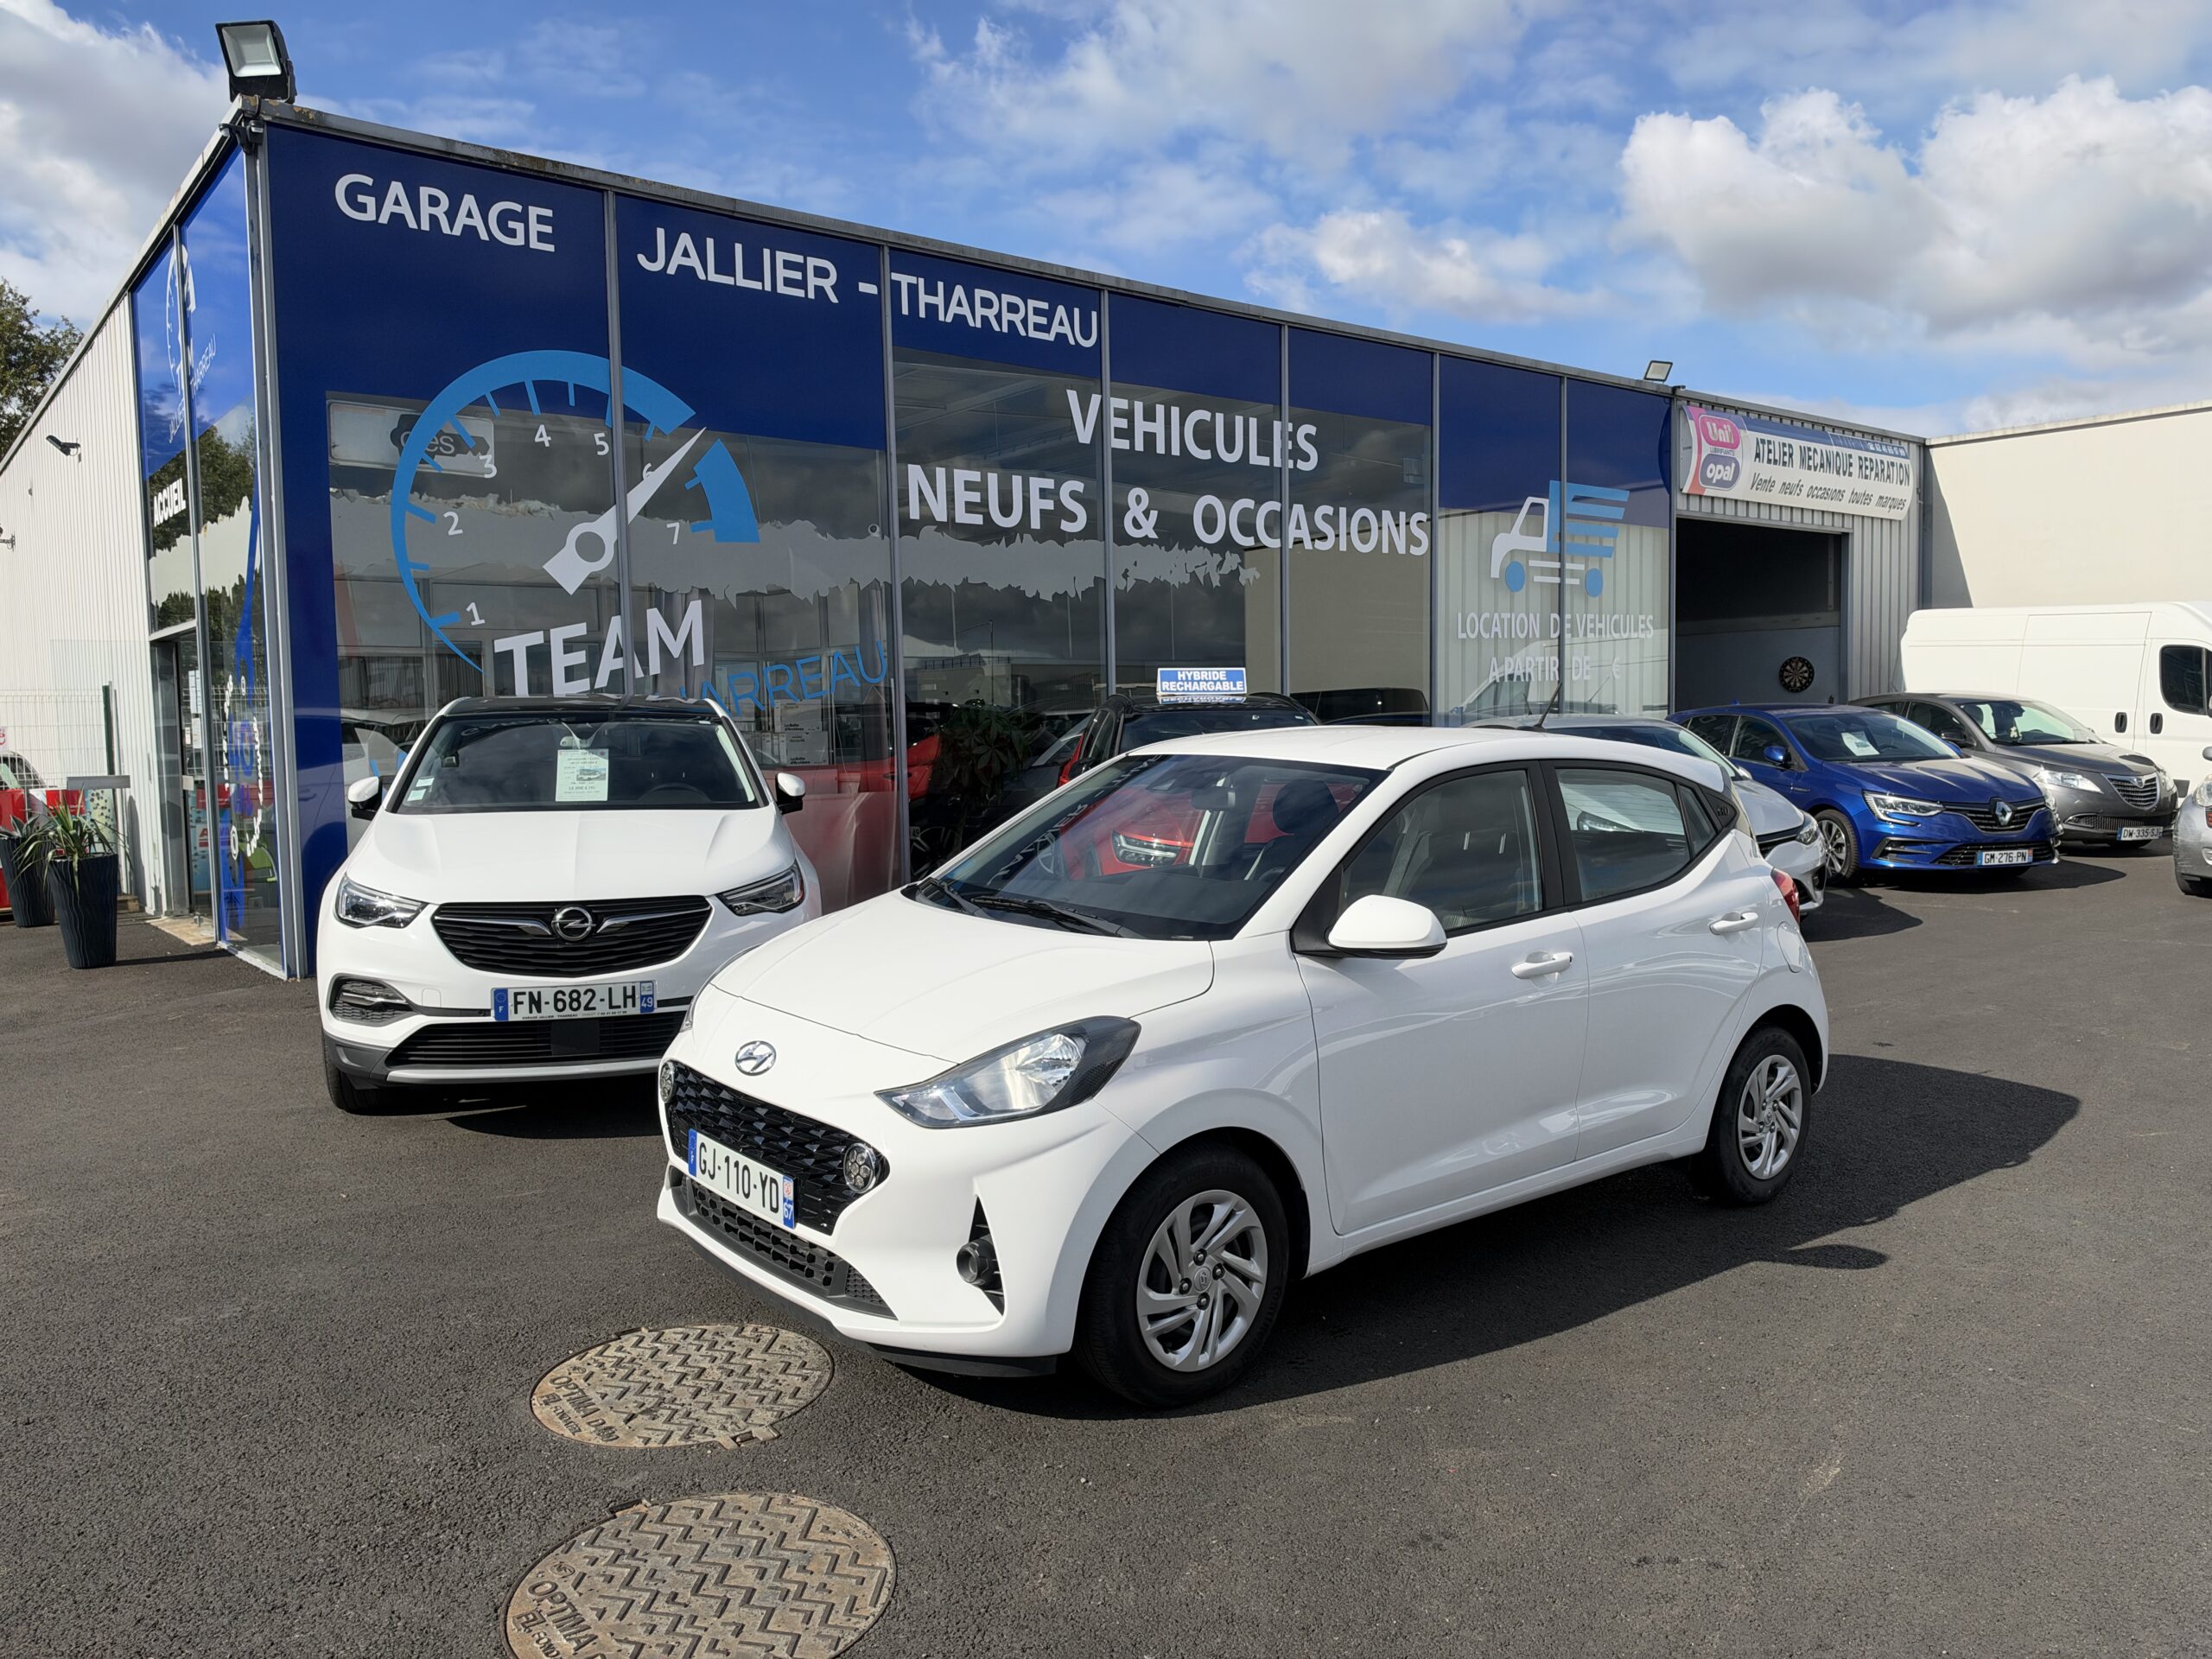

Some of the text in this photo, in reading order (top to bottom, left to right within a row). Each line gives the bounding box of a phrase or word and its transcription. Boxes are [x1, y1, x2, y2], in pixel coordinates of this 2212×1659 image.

[335, 174, 556, 252] GARAGE
[637, 228, 839, 303] JALLIER
[891, 272, 1098, 347] THARREAU
[534, 424, 552, 447] 4
[594, 432, 610, 456] 5
[1066, 389, 1319, 471] VEHICULES
[1707, 421, 1734, 443] Unil
[479, 454, 498, 479] 3
[1707, 462, 1735, 484] opal
[1754, 436, 1910, 487] ATELIER MECANIQUE REPARATION
[153, 477, 186, 528] ACCUEIL
[1750, 473, 1907, 514] Vente neufs occasions toutes marques
[443, 512, 463, 536] 2
[907, 464, 1430, 556] NEUFS & OCCASIONS
[666, 522, 681, 545] 7
[466, 602, 486, 626] 1
[1458, 612, 1655, 639] LOCATION DE VEHICULES
[493, 600, 704, 697] TEAM
[1178, 671, 1227, 681] HYBRIDE
[1488, 656, 1501, 683] A
[1504, 656, 1560, 683] PARTIR
[1571, 655, 1592, 682] DE
[1161, 681, 1243, 691] RECHARGABLE
[1984, 851, 2027, 864] GM-276-PN
[513, 985, 637, 1015] FN-682-LH
[641, 996, 653, 1008] 49
[699, 1142, 779, 1214] GJ-110-YD
[784, 1202, 793, 1220] 67
[550, 1376, 601, 1418] OPTIMA
[528, 1580, 599, 1651] OPTIMA
